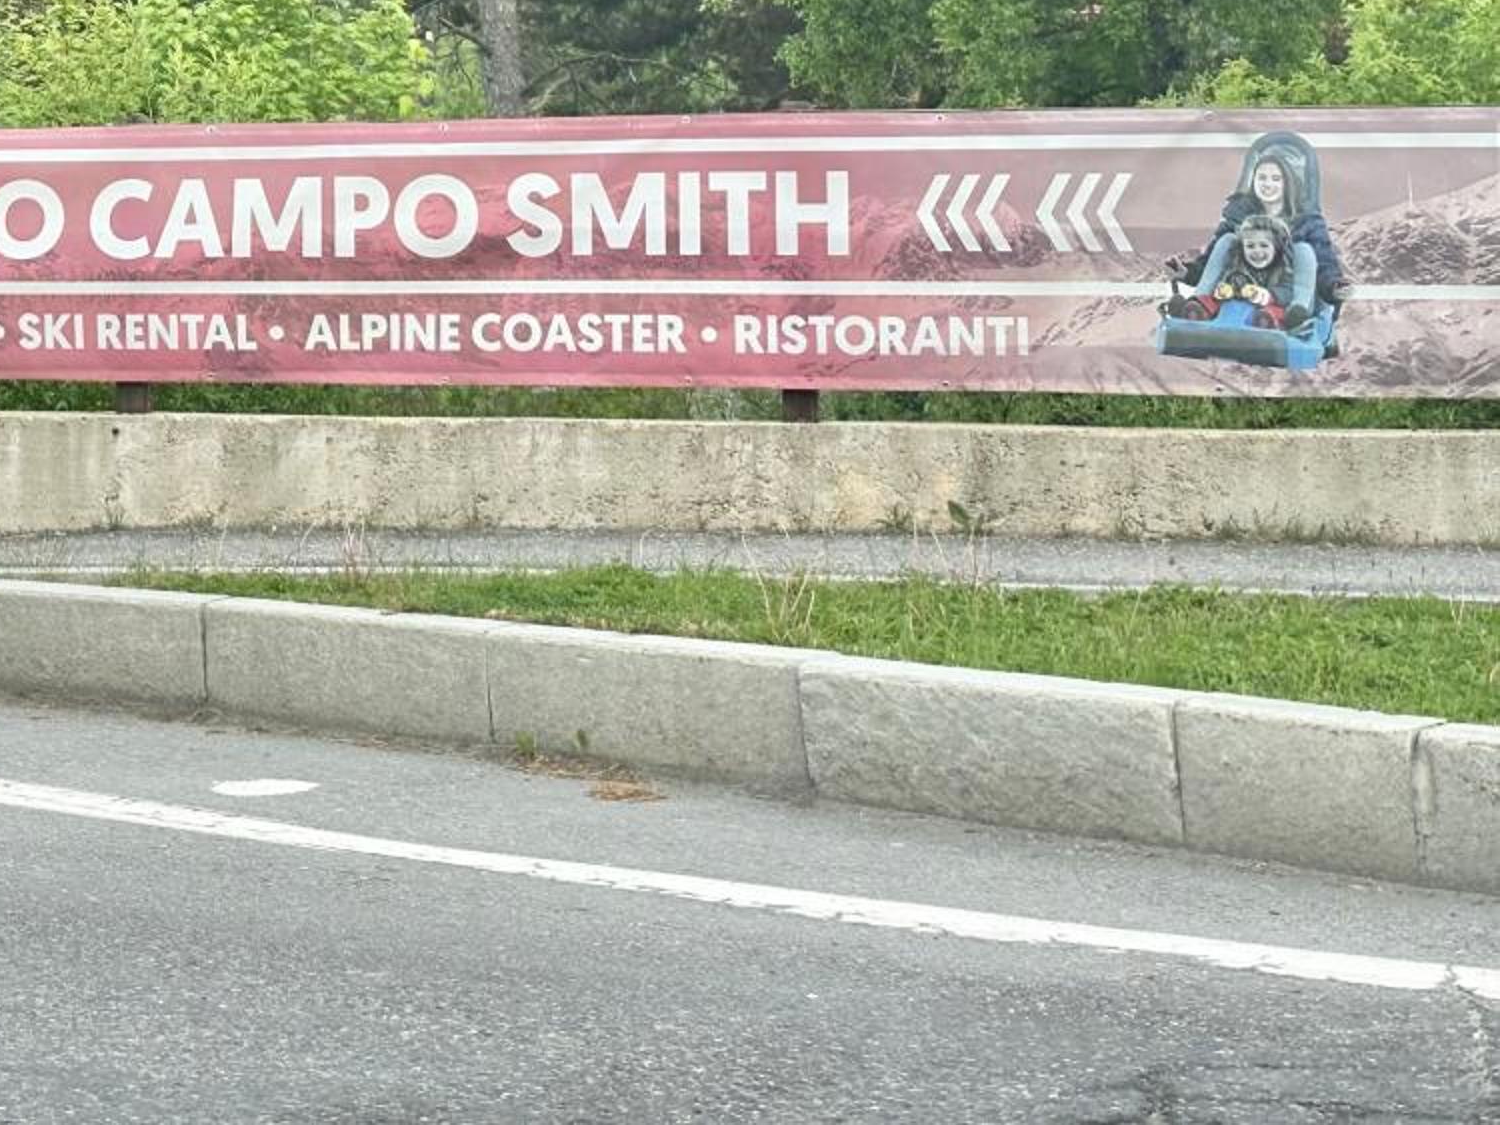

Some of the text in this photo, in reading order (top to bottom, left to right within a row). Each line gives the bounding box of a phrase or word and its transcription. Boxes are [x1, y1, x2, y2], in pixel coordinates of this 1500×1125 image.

[90, 174, 478, 259] CAMPO
[507, 171, 849, 257] SMITH
[19, 313, 84, 349] SKI
[97, 314, 257, 350] RENTAL
[305, 314, 460, 351] ALPINE
[472, 313, 686, 352] COASTER
[735, 315, 1032, 355] RISTORANTI
